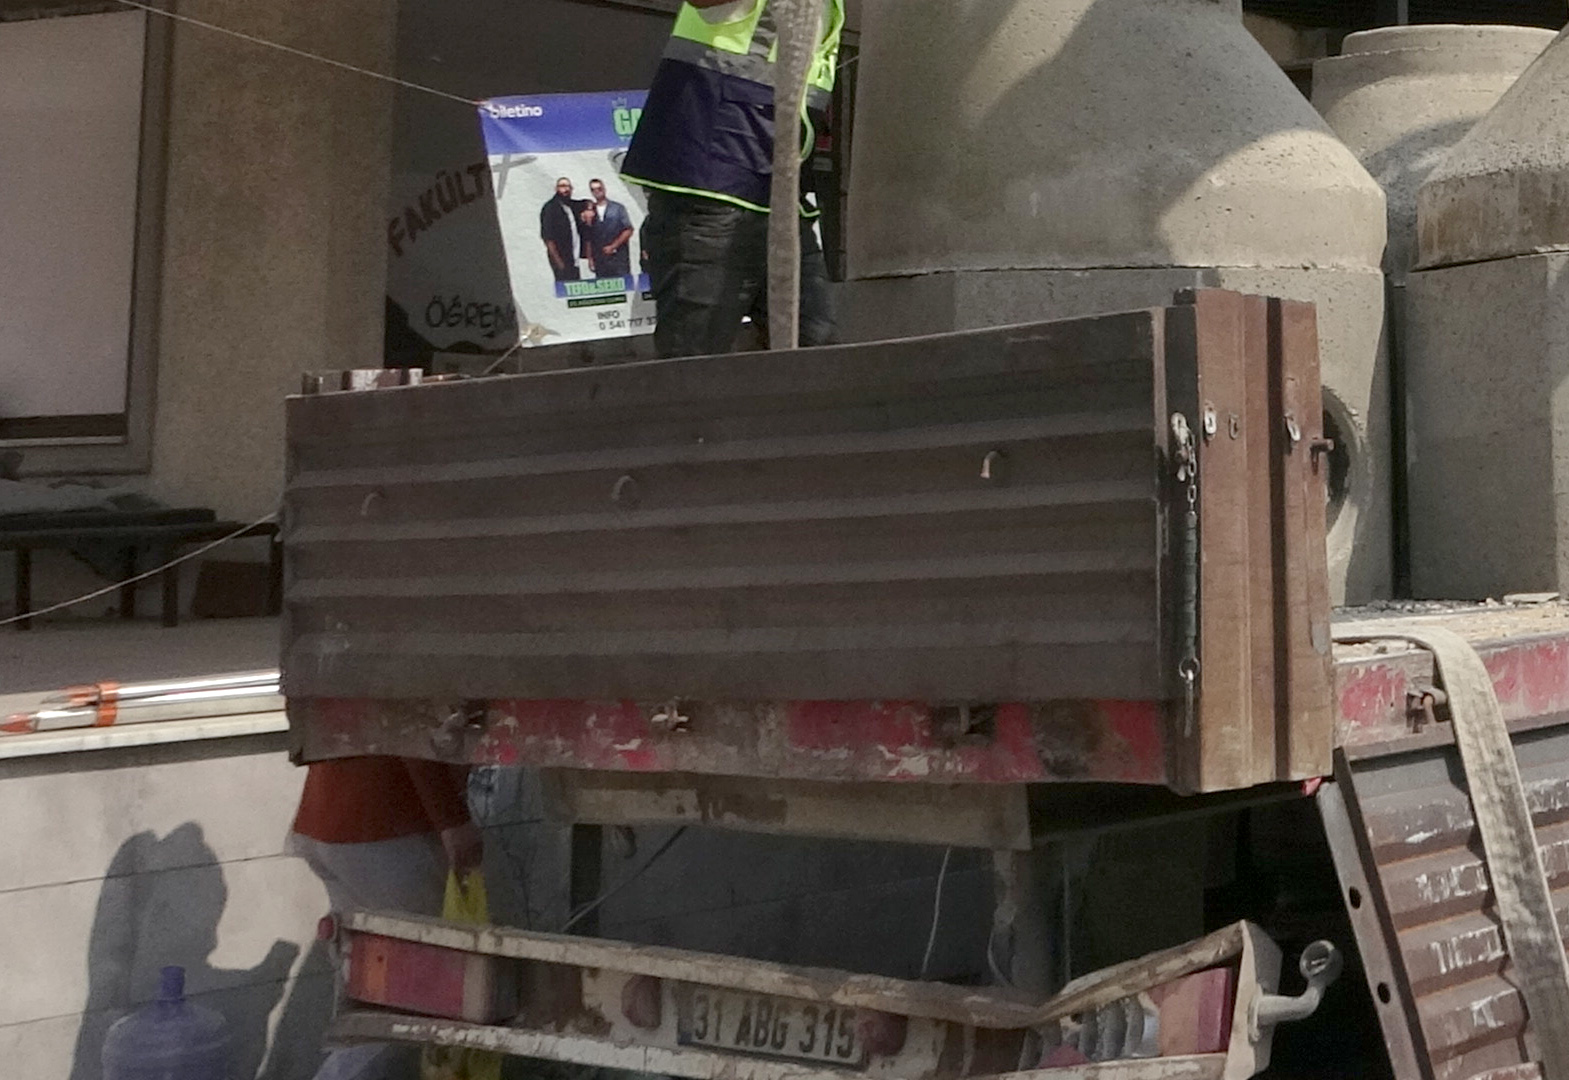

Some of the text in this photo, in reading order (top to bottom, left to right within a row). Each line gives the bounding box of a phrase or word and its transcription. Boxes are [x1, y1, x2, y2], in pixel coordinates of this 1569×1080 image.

[489, 103, 544, 119] biletino
[387, 162, 494, 258] FAKÜLT
[597, 309, 621, 321] INFO
[694, 992, 858, 1060] 31 ABG 315
